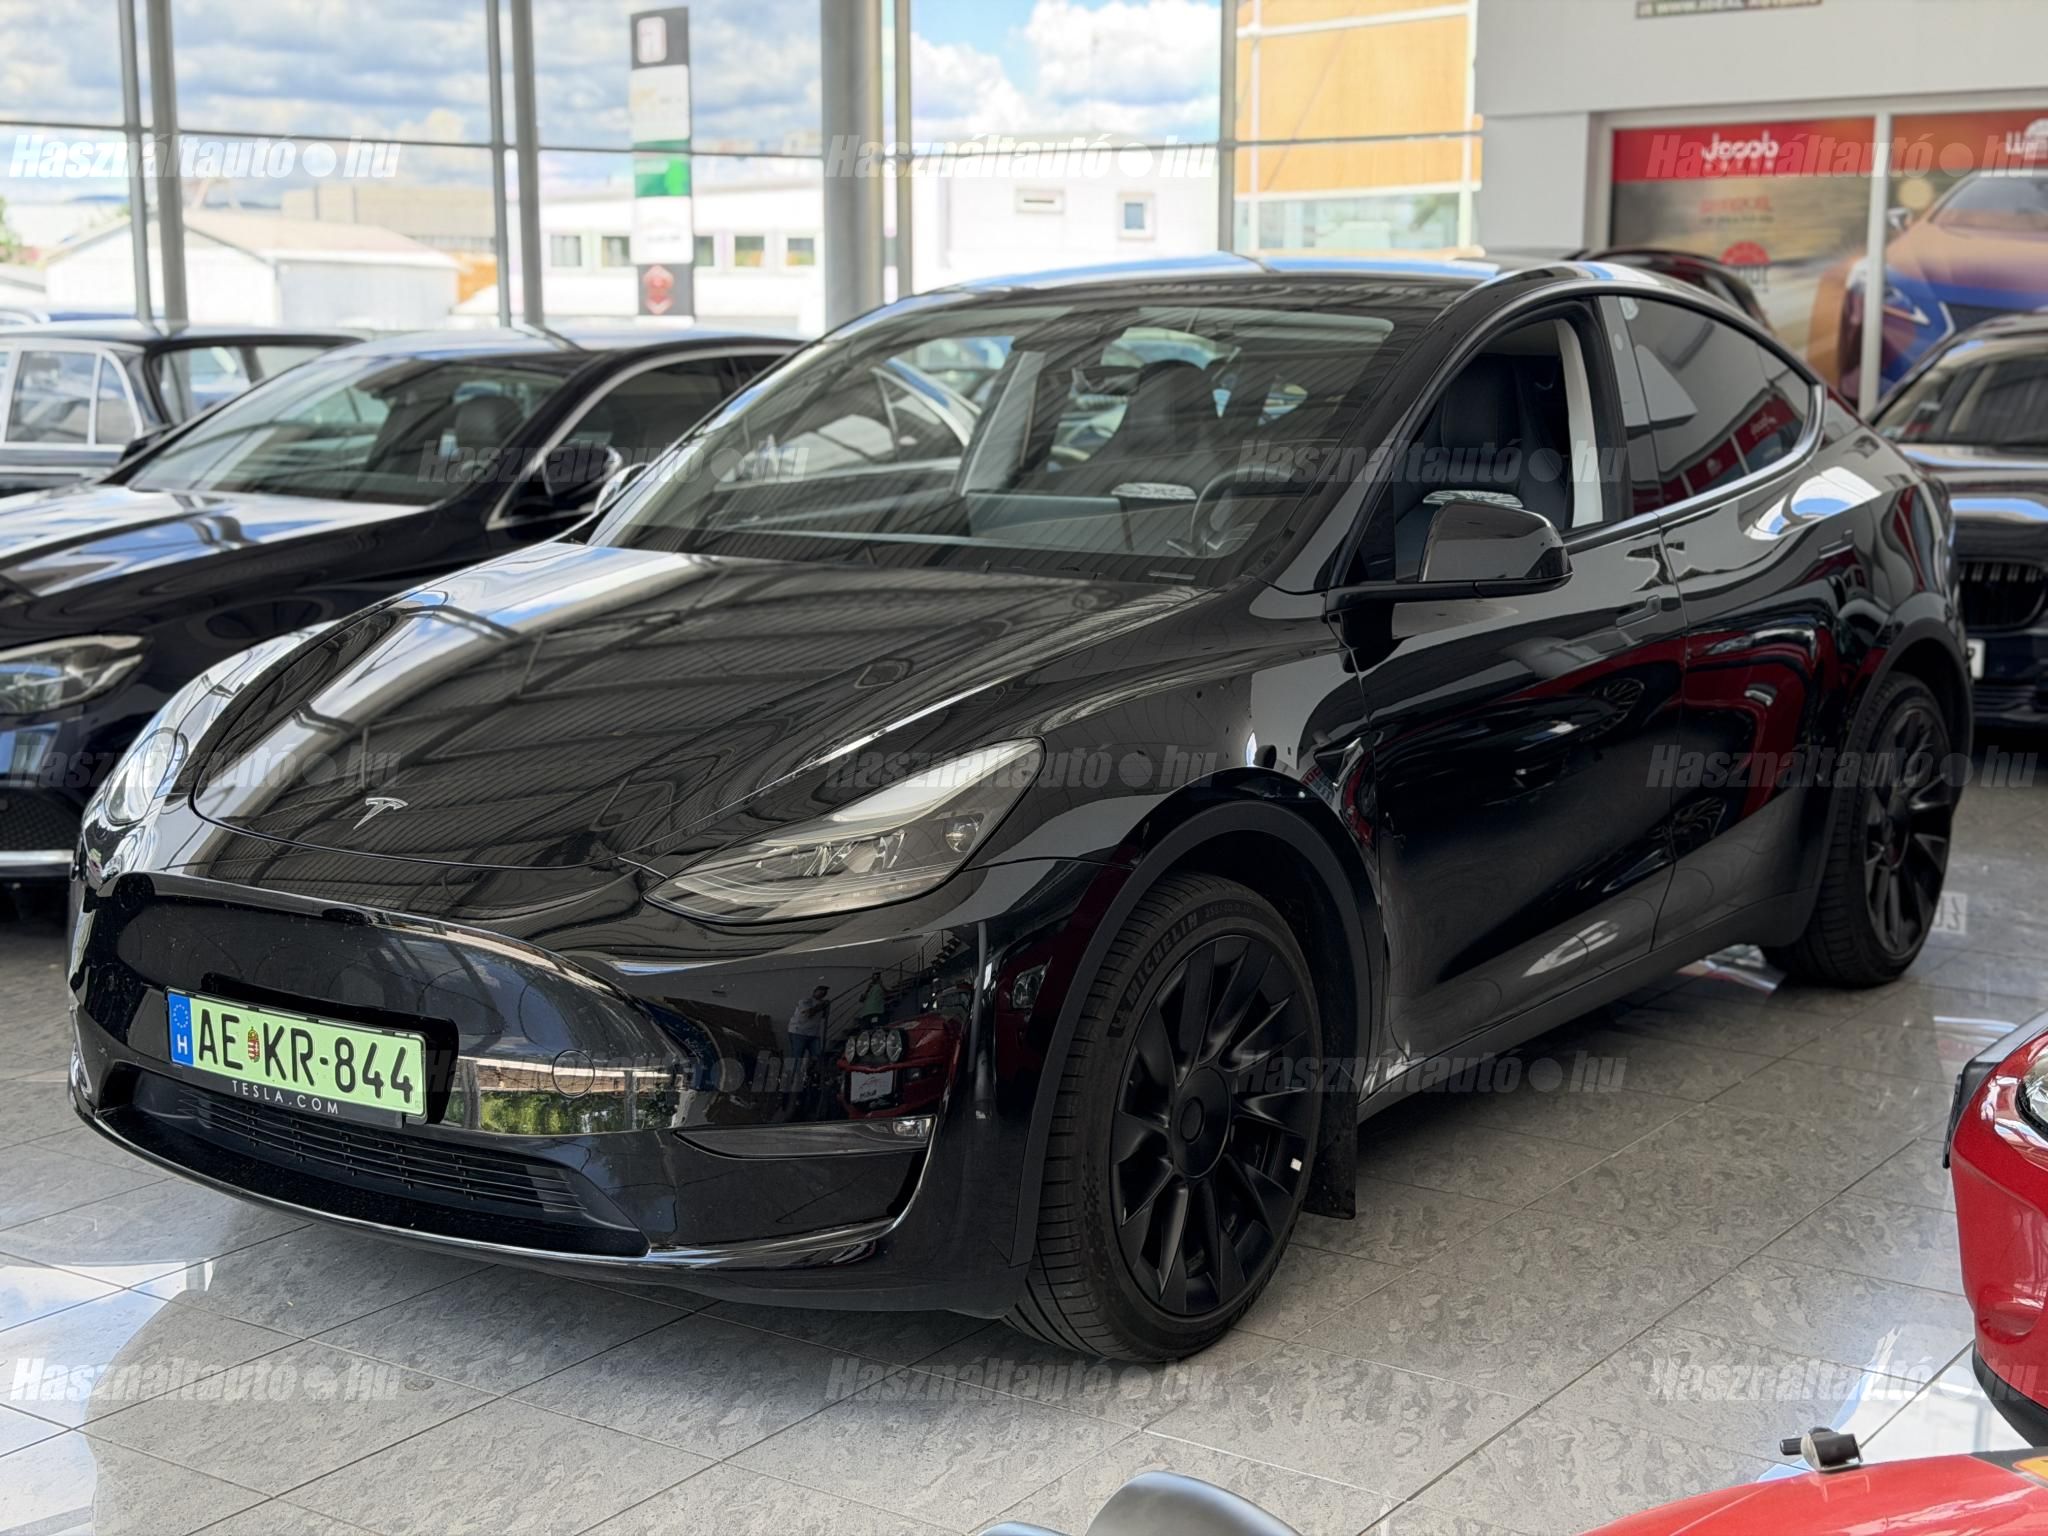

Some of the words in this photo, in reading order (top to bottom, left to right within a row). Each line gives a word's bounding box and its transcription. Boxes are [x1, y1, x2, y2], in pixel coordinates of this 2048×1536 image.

[1126, 911, 1199, 1005] MICHELIN
[176, 1034, 188, 1056] H
[199, 1008, 243, 1070] AE
[263, 1022, 413, 1104] KR-844
[231, 1079, 339, 1115] TESLA.COM
